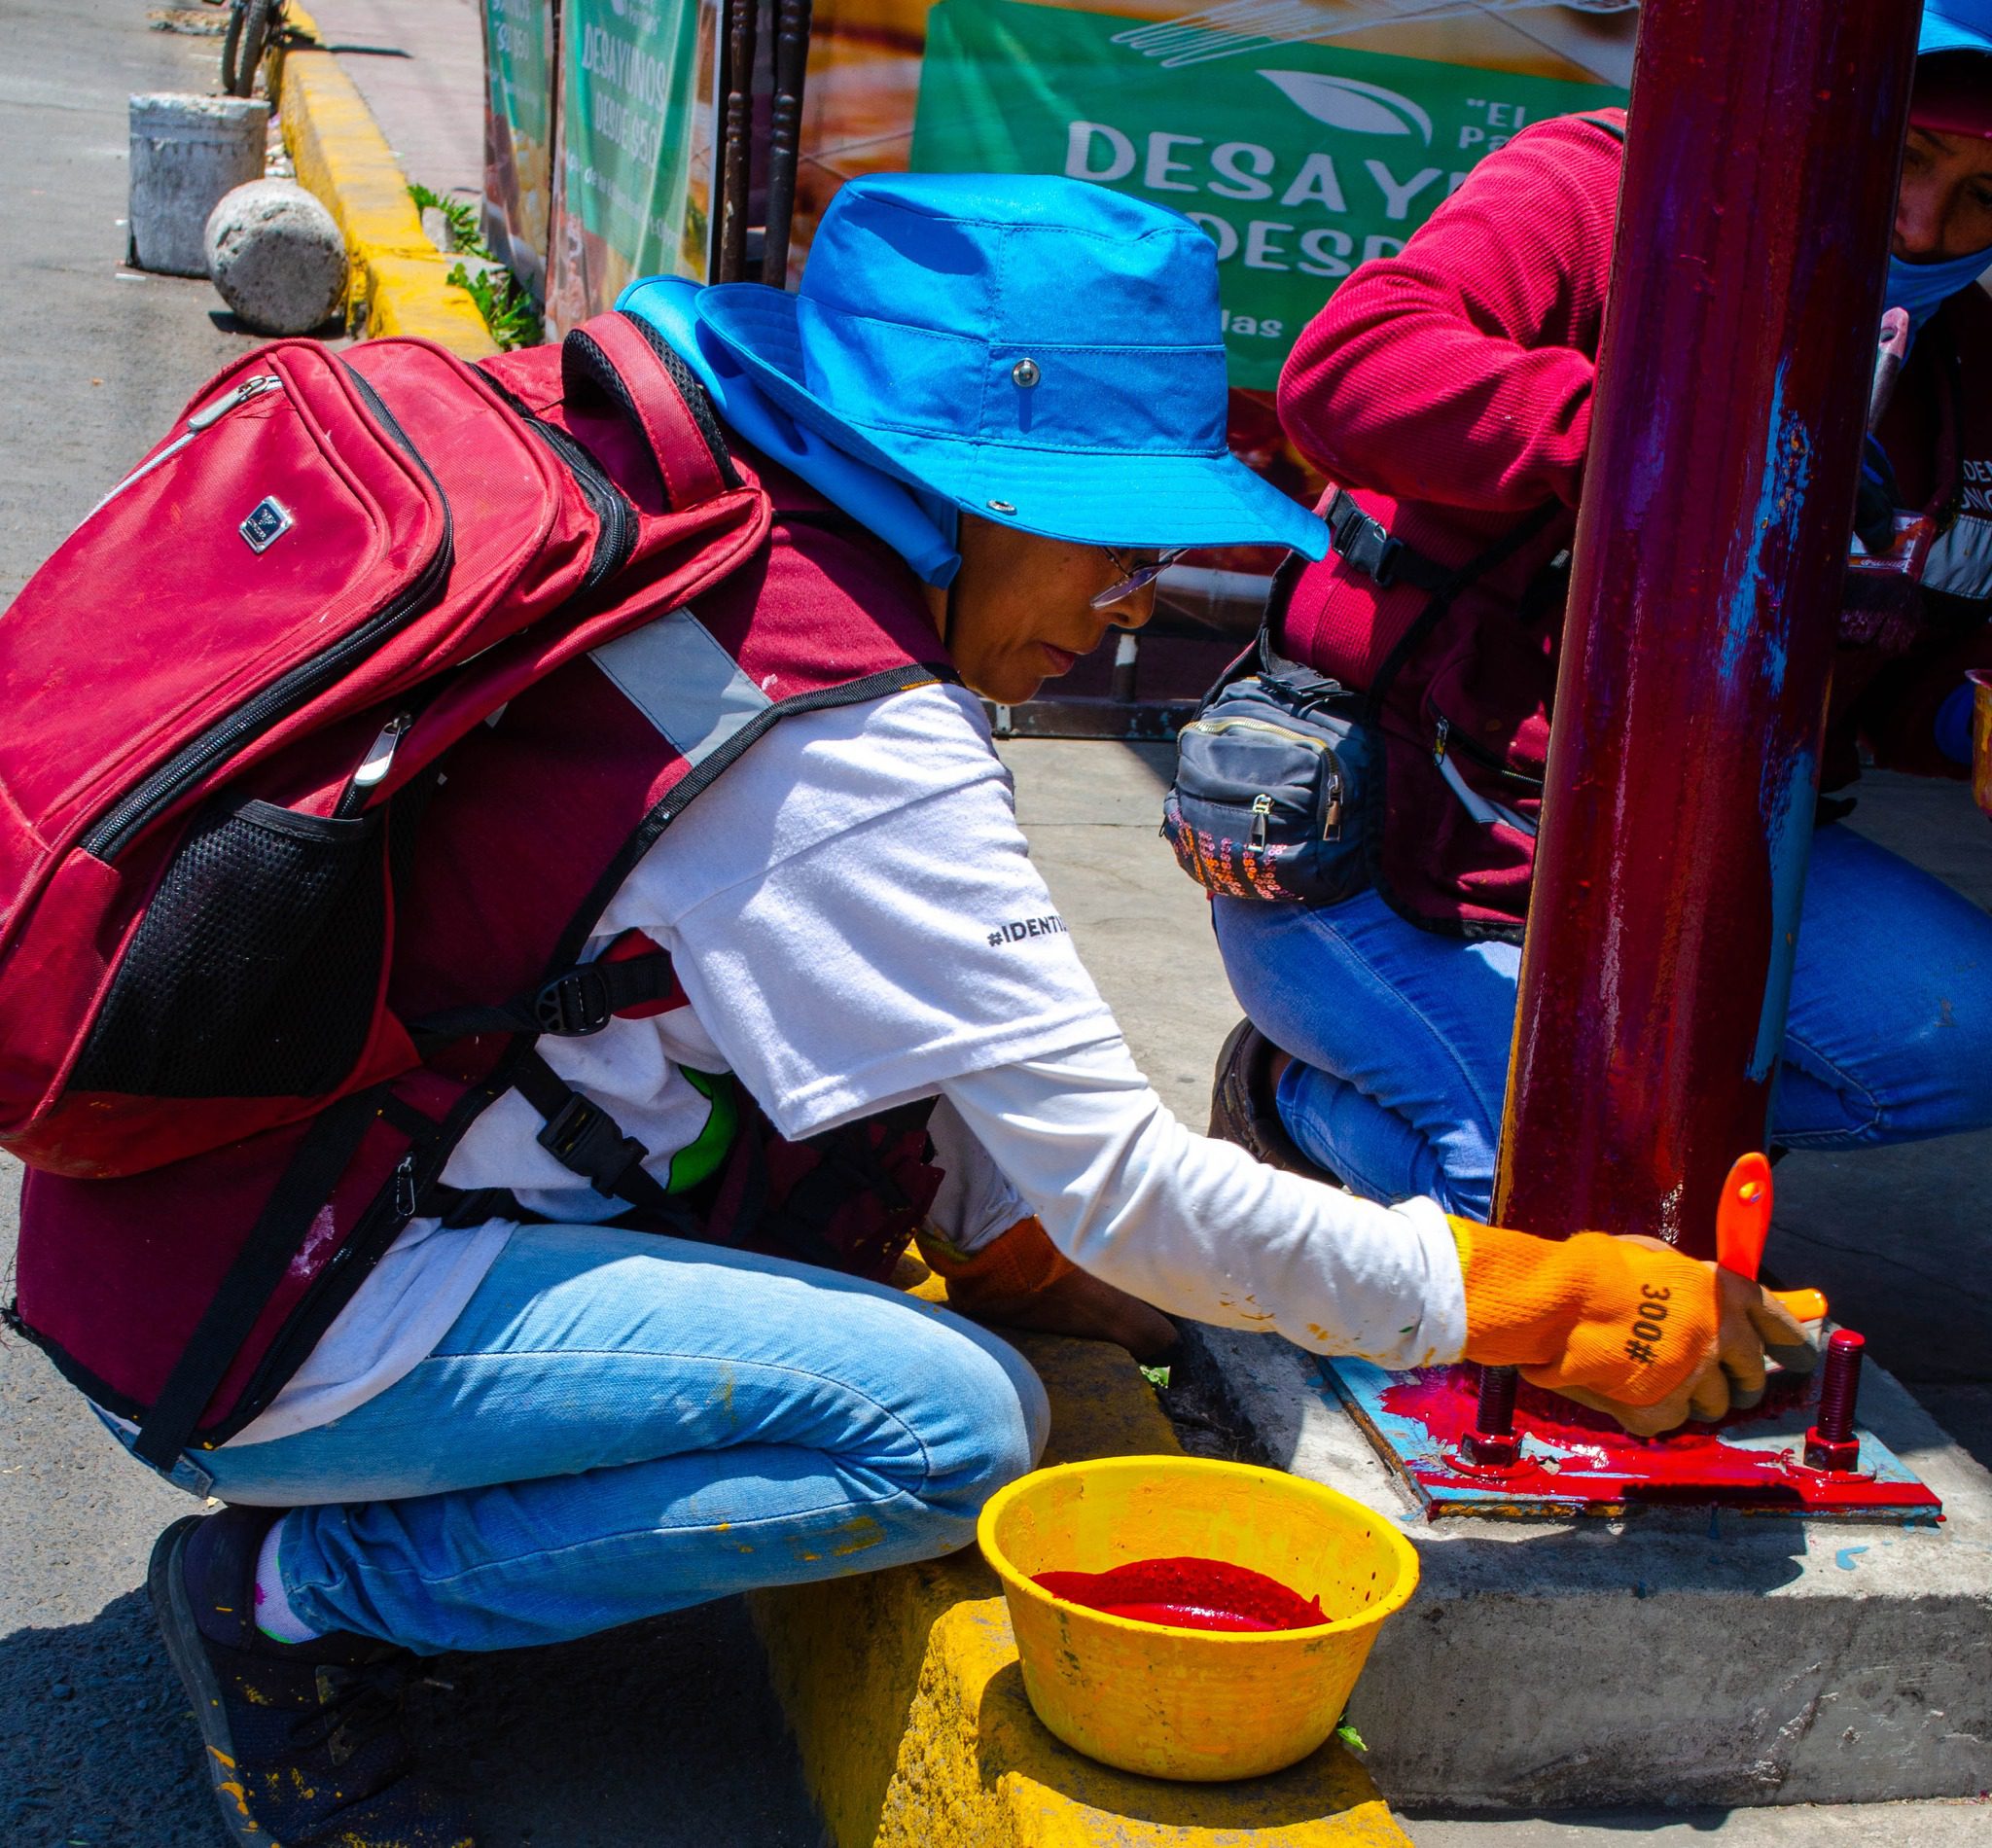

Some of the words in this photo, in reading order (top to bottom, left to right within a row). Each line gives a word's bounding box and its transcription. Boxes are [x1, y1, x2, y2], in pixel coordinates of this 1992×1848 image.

[582, 21, 665, 115] DESAYUNOS
[1065, 120, 1469, 221] DESAY
[986, 915, 1068, 947] #IDENTI
[1623, 1283, 1672, 1368] 300#
